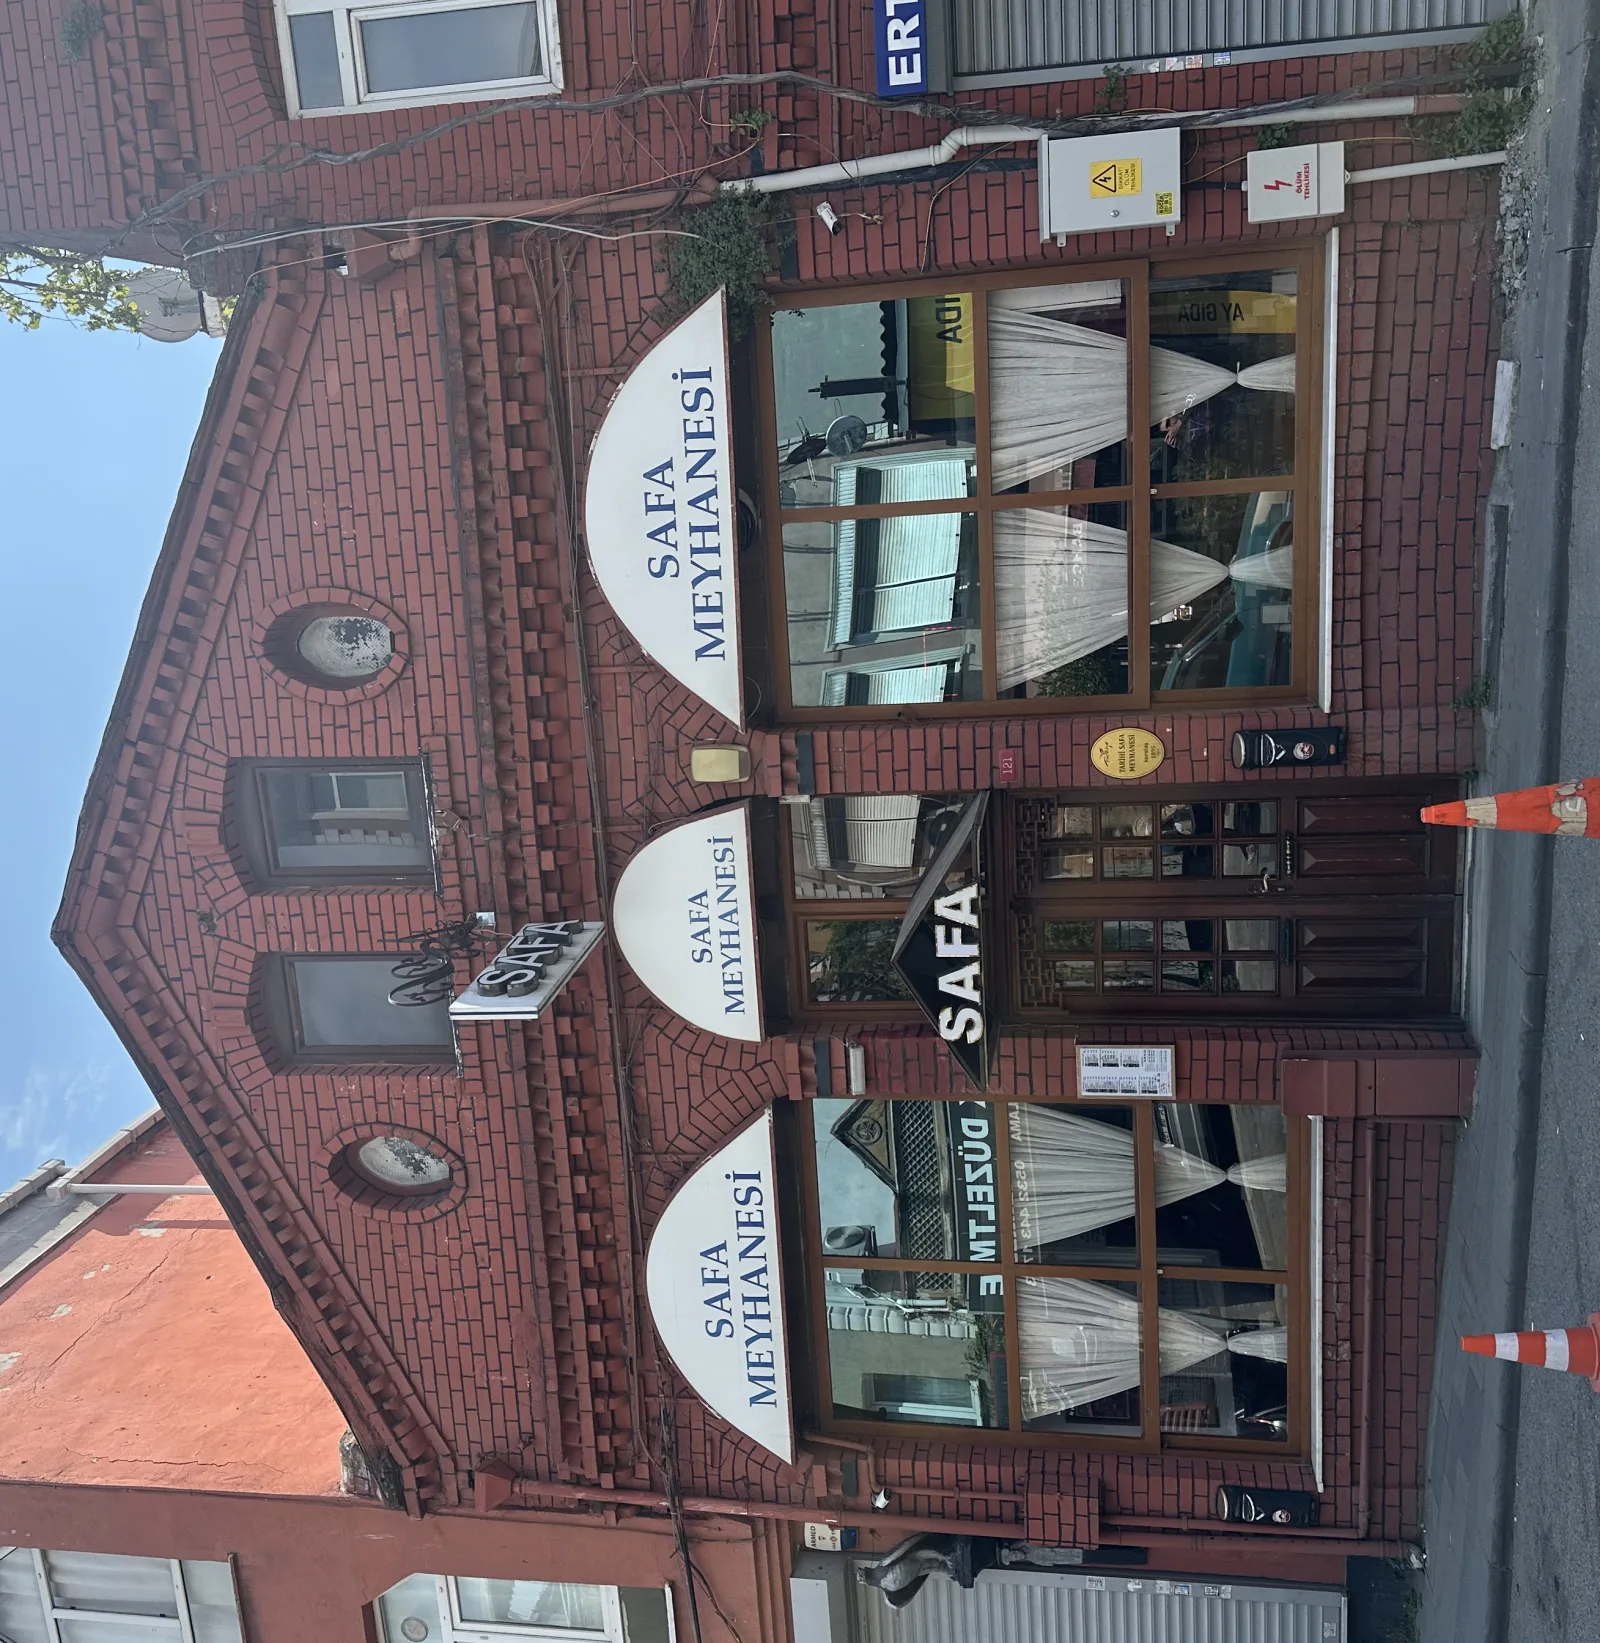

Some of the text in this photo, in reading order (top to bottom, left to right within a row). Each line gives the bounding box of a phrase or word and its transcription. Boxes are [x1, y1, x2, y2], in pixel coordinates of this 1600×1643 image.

[643, 457, 679, 579] SAFA
[671, 366, 725, 661] MEYHANESİ
[1002, 756, 1013, 774] 121
[1118, 752, 1126, 773] TARİHİ
[1128, 734, 1136, 772] MEYHANESİ
[476, 920, 581, 993] SAFA
[688, 889, 712, 963] SAFA
[707, 835, 745, 1015] MEYHANESİ
[934, 883, 984, 1044] SAFA
[700, 1240, 734, 1338] SAFA
[724, 1170, 778, 1408] MEYHANESİ
